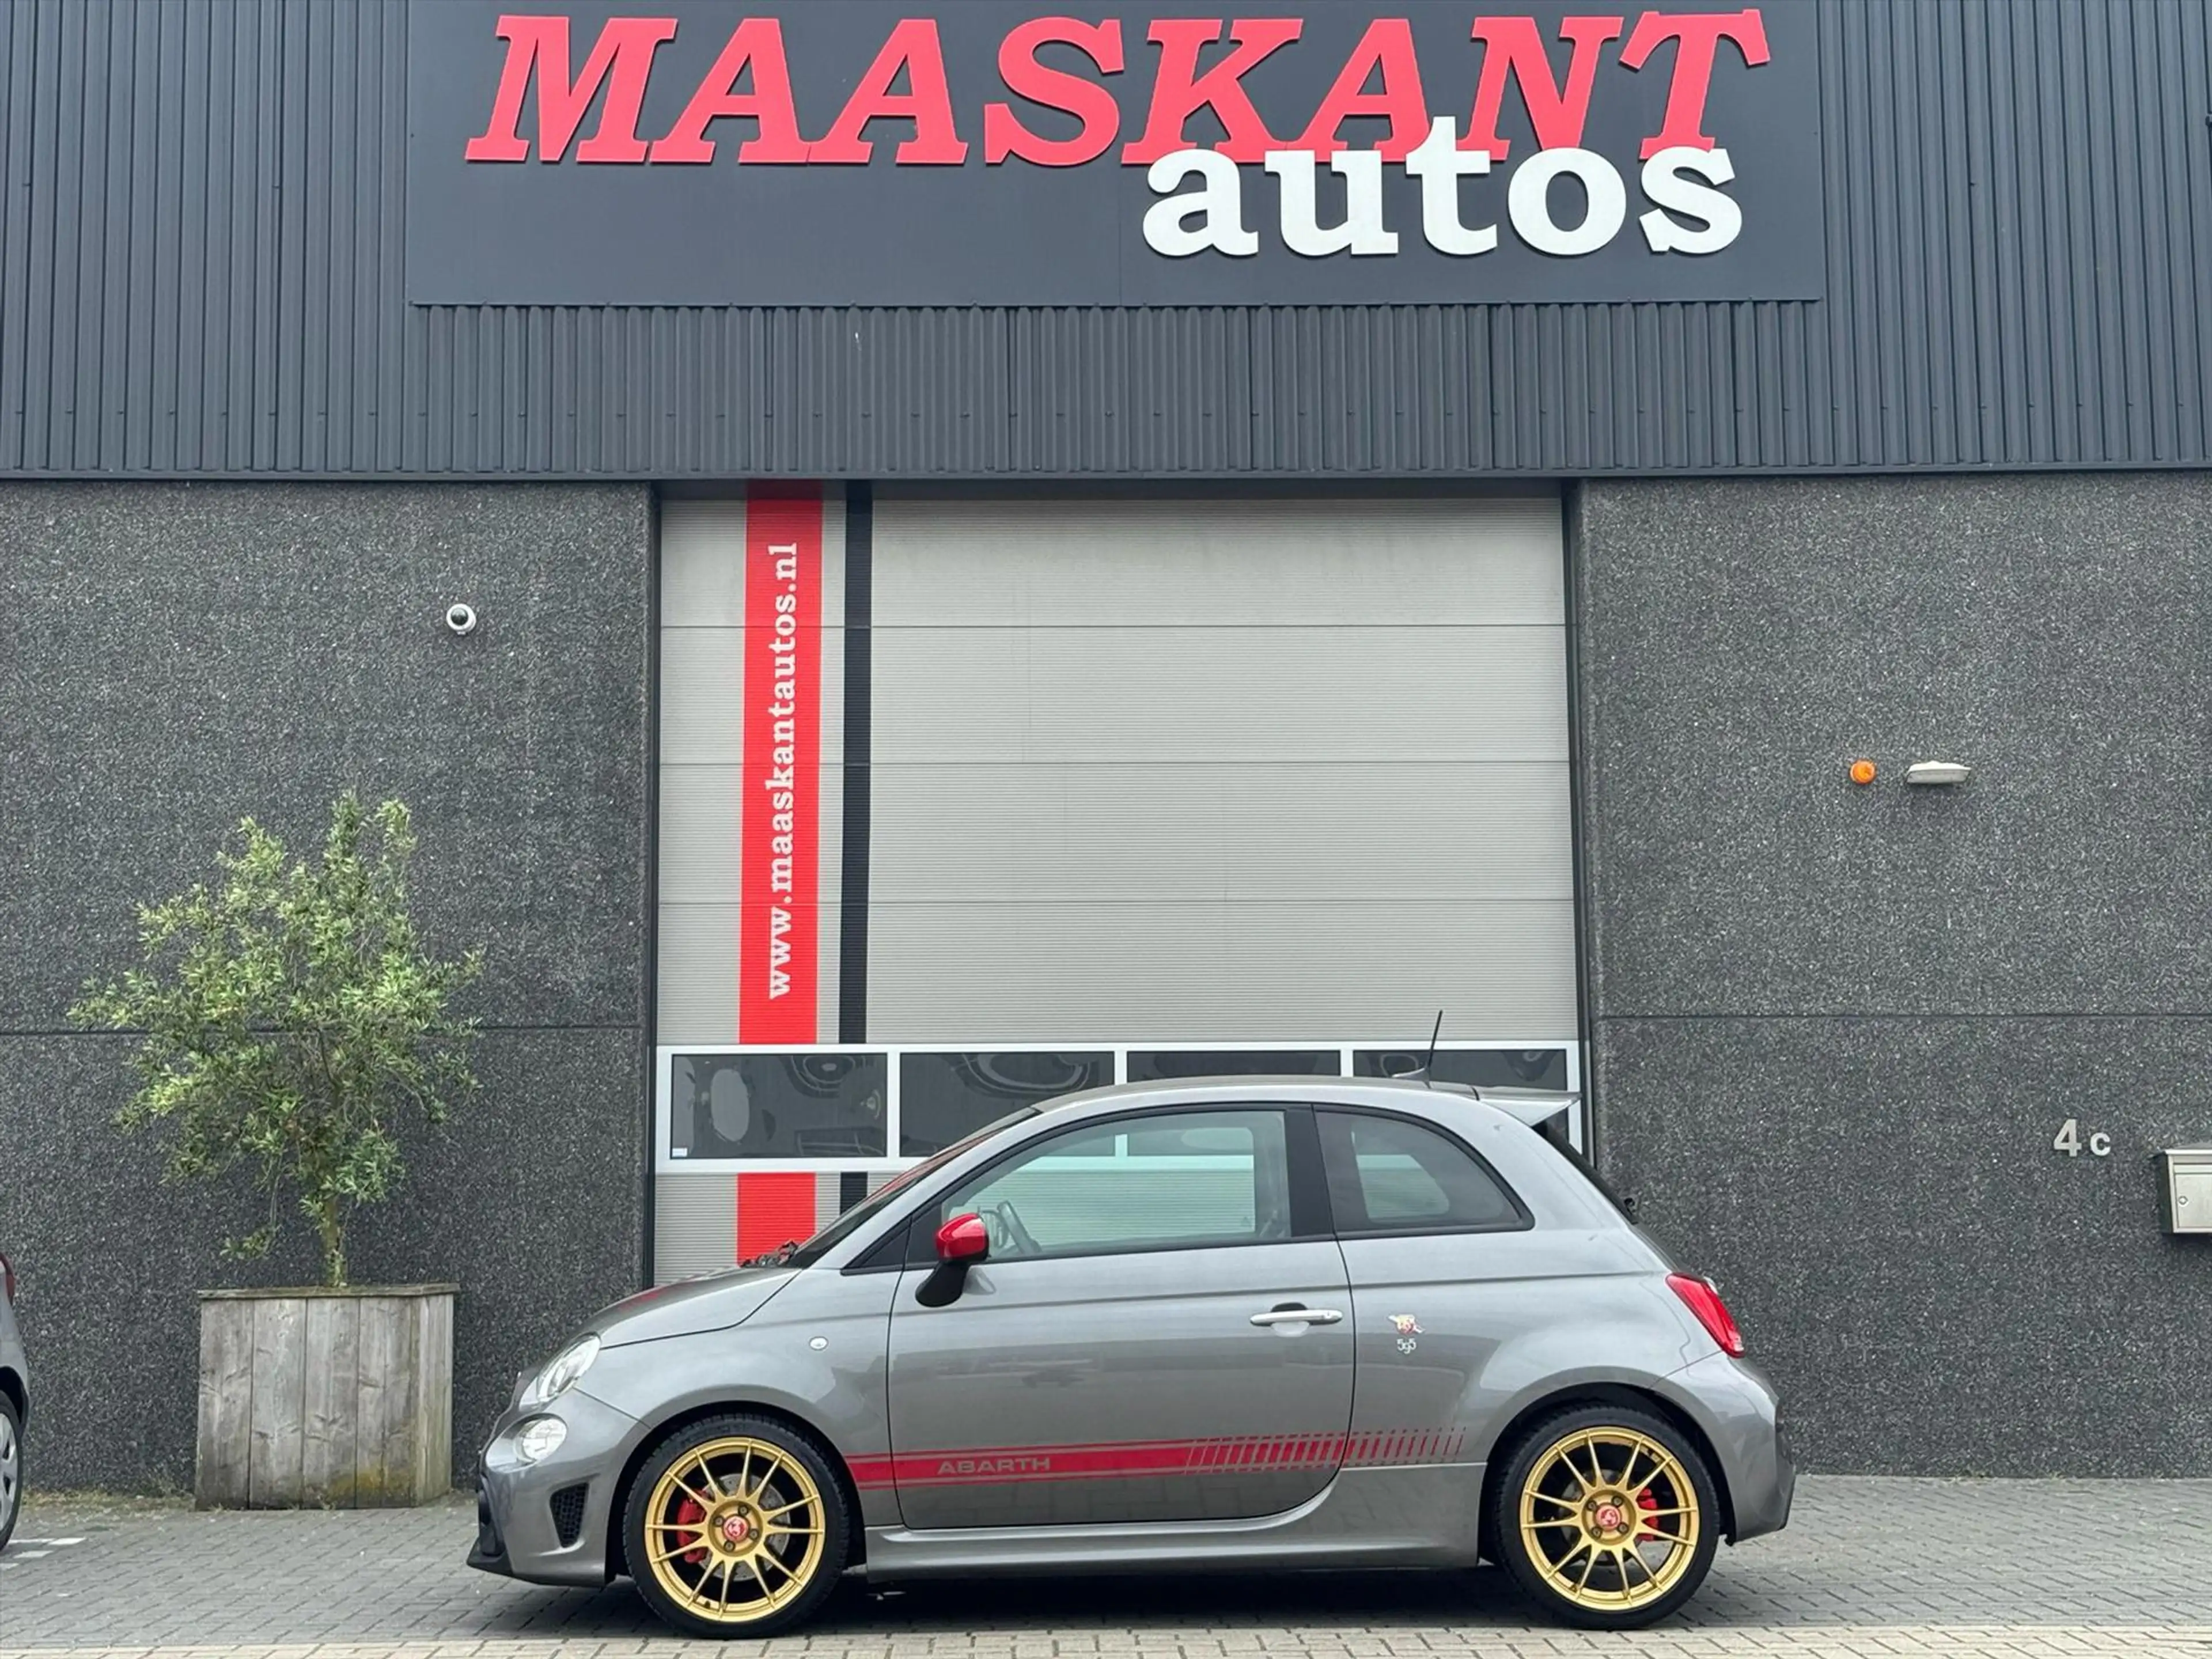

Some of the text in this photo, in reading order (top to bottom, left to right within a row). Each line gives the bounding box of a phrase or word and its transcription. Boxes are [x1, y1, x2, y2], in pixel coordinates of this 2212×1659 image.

[464, 9, 1770, 166] MAASKANT
[1143, 116, 1743, 256] autos
[764, 542, 797, 999] www.maaskantautos.nl
[937, 1457, 1051, 1475] ABARTH
